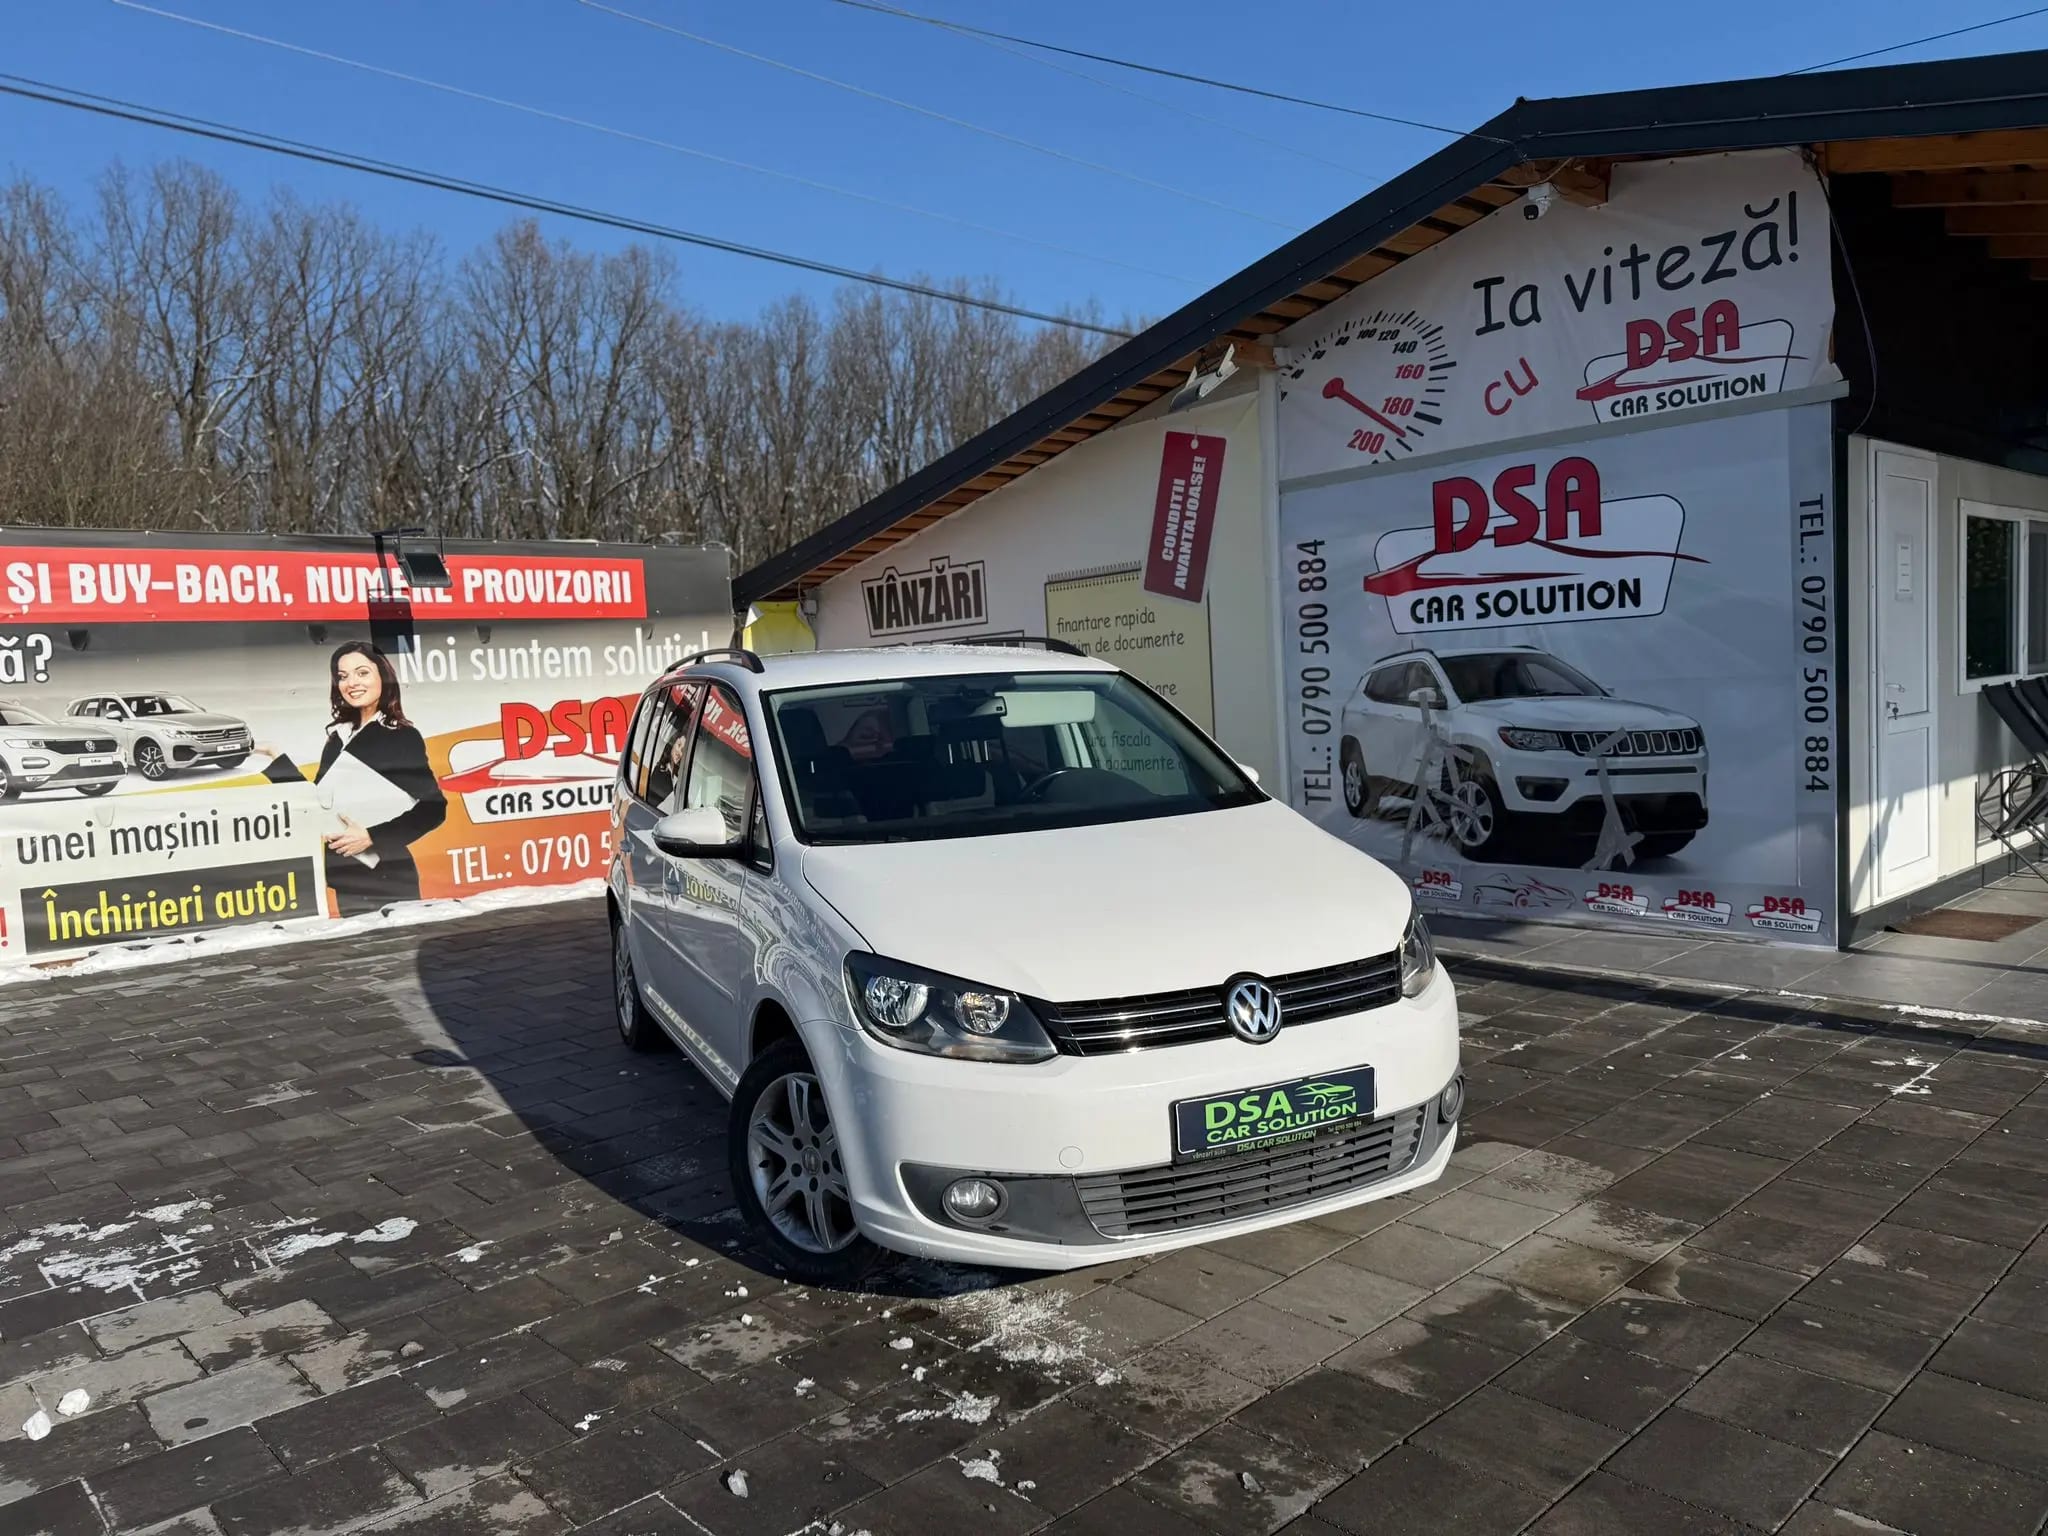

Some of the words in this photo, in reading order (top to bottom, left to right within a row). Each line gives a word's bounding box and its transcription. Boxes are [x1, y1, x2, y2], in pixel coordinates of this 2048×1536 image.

[1473, 276, 1541, 336] Ia
[1565, 191, 1799, 313] viteză!
[1357, 328, 1377, 339] 100
[1378, 329, 1400, 341] 120
[1392, 340, 1418, 354] 140
[1627, 299, 1740, 371] DSA
[1395, 364, 1425, 379] 160
[1484, 357, 1539, 416] cu
[1381, 397, 1414, 416] 180
[1610, 394, 1649, 418] CAR
[1655, 373, 1766, 408] SOLUTION
[1347, 429, 1385, 454] 200
[1174, 455, 1207, 590] AVANTAJOASE!
[1432, 457, 1602, 553] DSA
[1799, 494, 1824, 563] TEL.:
[463, 568, 633, 603] PROVIZORII
[1297, 539, 1328, 594] 884
[866, 564, 983, 630] VÂNZĂRI
[1410, 592, 1464, 625] CAR
[1476, 576, 1642, 620] SOLUTION
[1802, 576, 1827, 653] 0790
[1056, 617, 1111, 634] finantare
[1115, 606, 1155, 631] rapida
[1095, 636, 1111, 654] de
[1114, 630, 1185, 652] documente
[1300, 602, 1331, 656] 500
[397, 635, 457, 683] Noi
[470, 640, 593, 681] suntem
[1301, 667, 1331, 735] 0790
[1803, 668, 1829, 723] 500
[500, 697, 629, 760] DSA
[1305, 747, 1332, 806] TEL.:
[1805, 735, 1830, 793] 884
[486, 793, 532, 815] CAR
[541, 784, 614, 814] SOLUT
[17, 820, 96, 865] unei
[110, 808, 220, 860] mașini
[233, 801, 292, 842] noi!
[447, 846, 512, 885] TEL.:
[521, 833, 591, 875] 0790
[1422, 869, 1451, 886] DSA
[41, 885, 204, 941] Închirieri
[215, 872, 298, 919] auto!
[1592, 905, 1604, 913] CAR
[1607, 906, 1641, 917] SOLUTION
[1599, 883, 1634, 901] DSA
[1678, 890, 1716, 908] DSA
[1764, 895, 1806, 915] DSA
[1671, 912, 1686, 920] CAR
[1689, 914, 1724, 925] SOLUTION
[1757, 919, 1772, 928] CAR
[1775, 921, 1813, 932] SOLUTION
[1205, 1090, 1293, 1130] DSA
[1206, 1124, 1250, 1143] CAR
[1257, 1102, 1357, 1134] SOLUTION
[1237, 1142, 1256, 1153] DSA
[1257, 1138, 1274, 1149] CAR
[1275, 1130, 1317, 1146] SOLUTION
